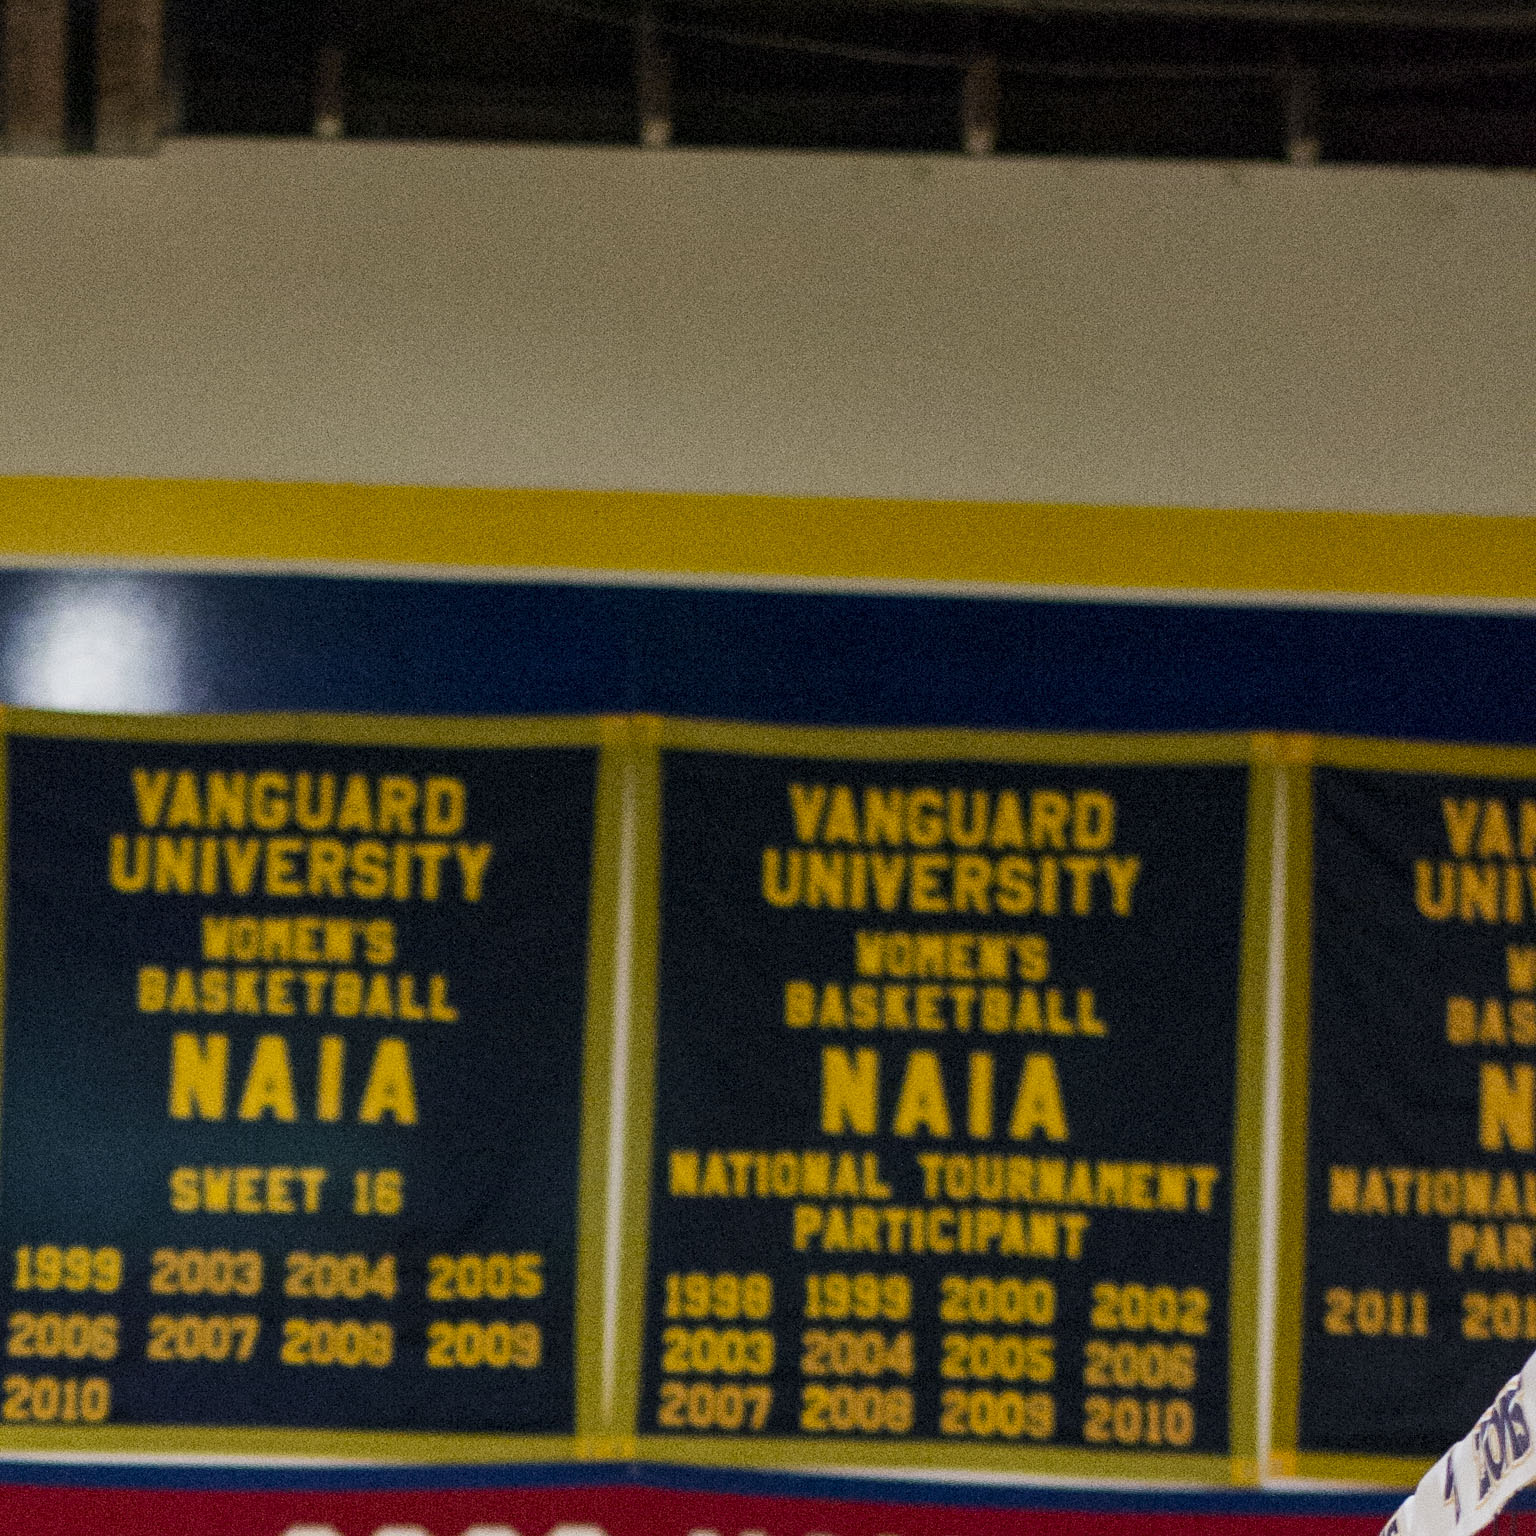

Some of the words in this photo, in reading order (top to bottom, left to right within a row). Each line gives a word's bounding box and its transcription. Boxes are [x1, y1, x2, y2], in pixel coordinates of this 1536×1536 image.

[134, 771, 464, 835] VANGUARD
[791, 786, 1113, 850] VANGUARD
[110, 835, 490, 901] UNIVERSITY
[763, 849, 1138, 914] UNIVERSITY
[1417, 863, 1536, 922] UNI
[204, 918, 394, 964] WOMEN'S
[858, 934, 1046, 980] WOMEN'S
[138, 967, 456, 1021] BASKETBALL
[785, 980, 1105, 1035] BASKETBALL
[170, 1033, 416, 1124] NAIA
[822, 1048, 1067, 1140] NAIA
[171, 1167, 325, 1212] SWEET
[355, 1170, 402, 1214] 16
[671, 1152, 889, 1198] NATIONAL
[920, 1153, 1217, 1209] TOURNAMENT
[794, 1205, 1087, 1257] PARTICIPANT
[16, 1244, 122, 1292] 1999
[151, 1249, 262, 1297] 2003
[284, 1250, 396, 1299] 2004
[427, 1252, 542, 1300] 2005
[666, 1274, 771, 1319] 1998
[807, 1272, 910, 1319] 1999
[941, 1276, 1054, 1325] 2000
[1091, 1281, 1209, 1335] 2002
[1325, 1288, 1427, 1336] 2011
[1463, 1293, 1536, 1339] 201
[147, 1315, 259, 1360] 2007
[663, 1326, 774, 1374] 2003
[802, 1328, 914, 1376] 2004
[941, 1333, 1054, 1383] 2005
[2, 1374, 109, 1424] 2010
[659, 1382, 772, 1429] 2007
[1084, 1395, 1193, 1447] 2010
